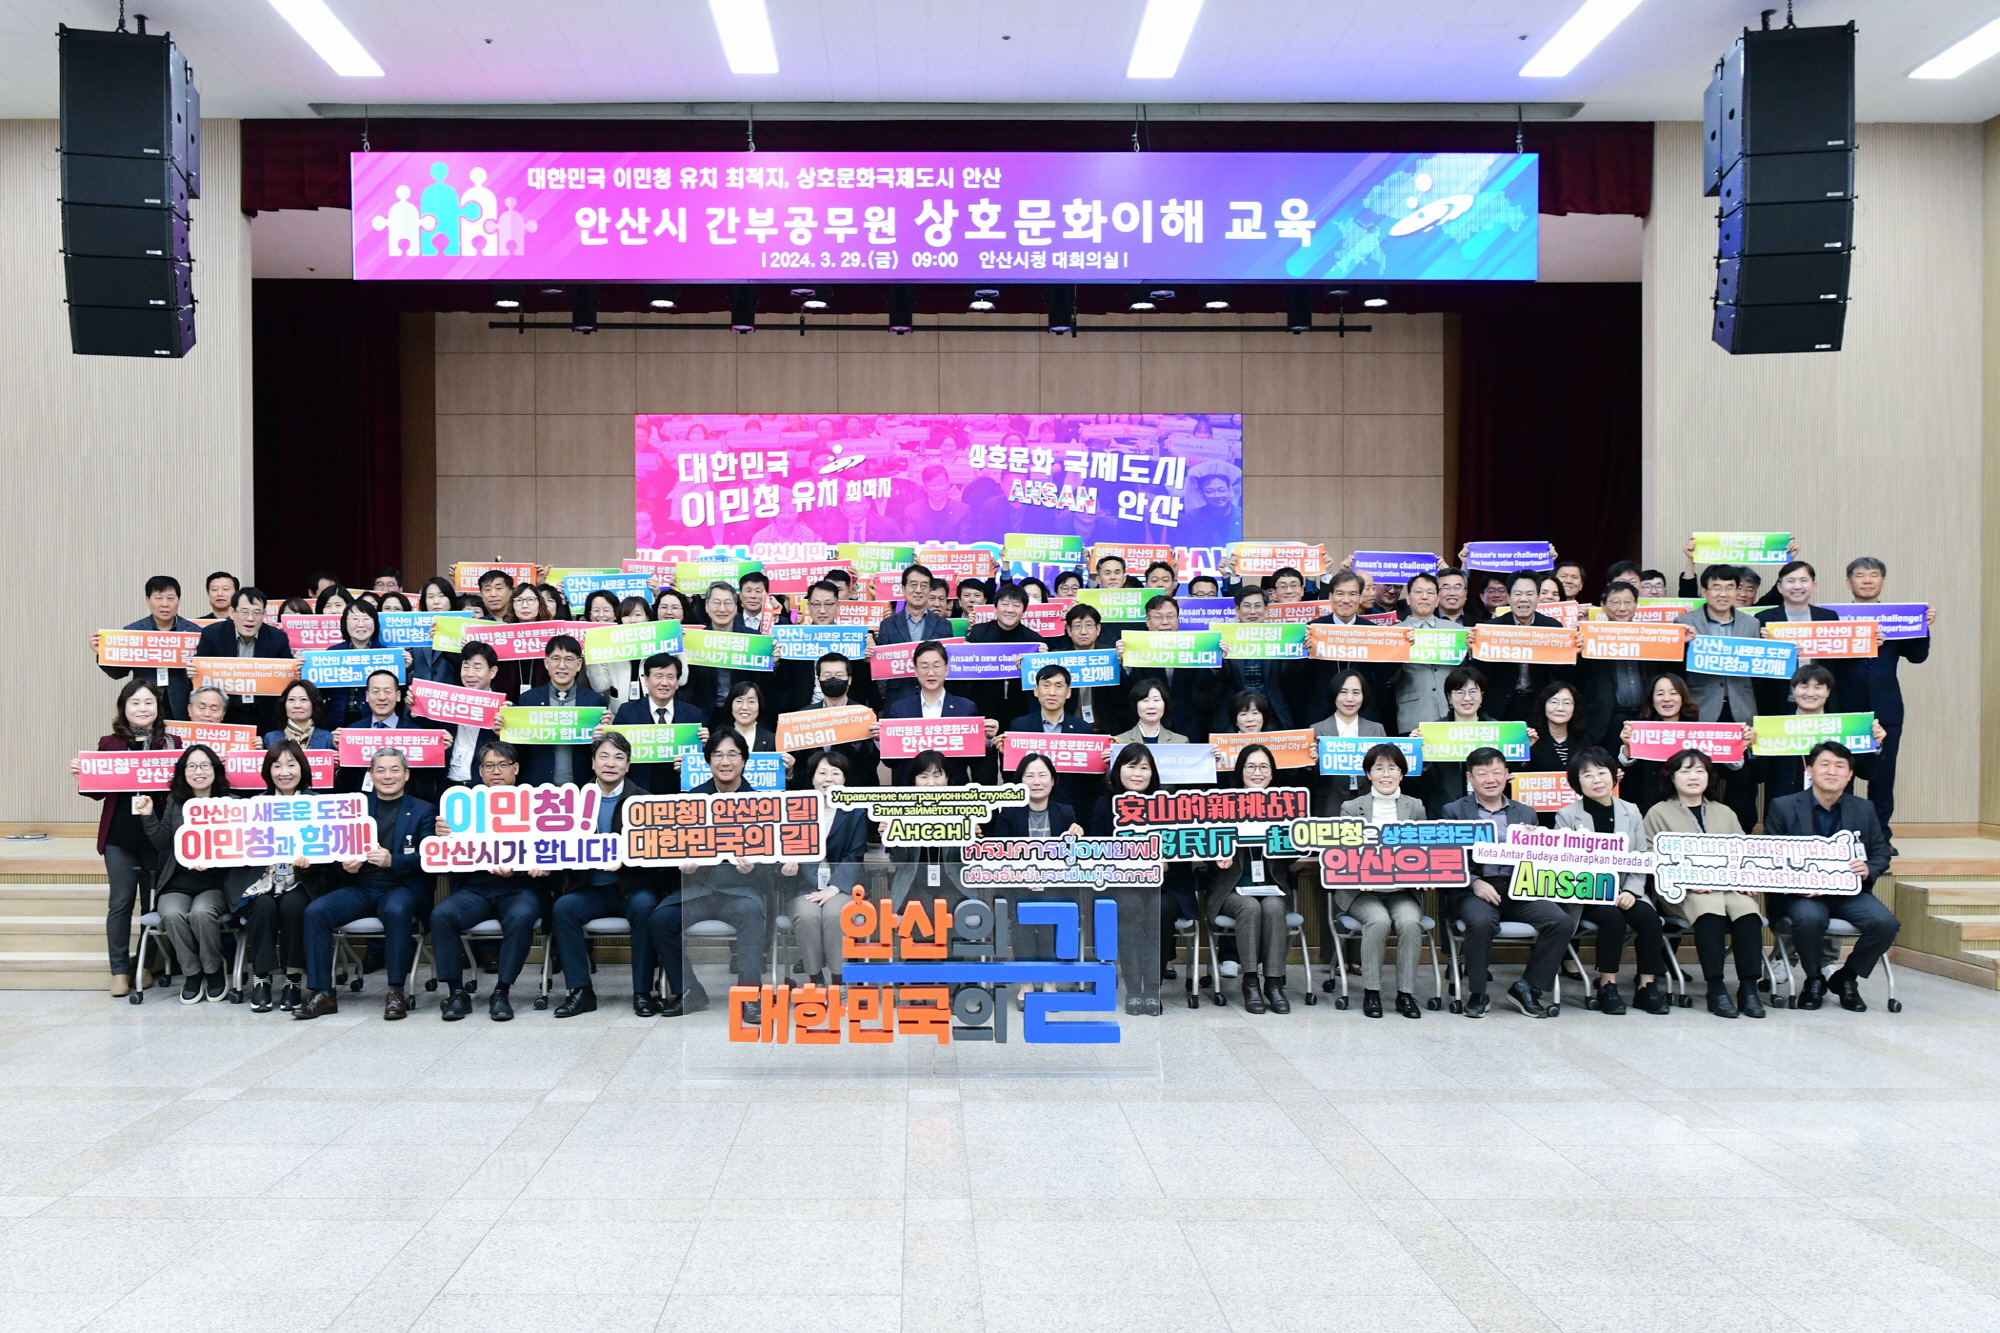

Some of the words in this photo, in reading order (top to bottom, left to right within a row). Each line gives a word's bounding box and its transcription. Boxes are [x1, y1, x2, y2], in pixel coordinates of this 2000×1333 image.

[527, 167, 606, 189] 대한민국
[613, 167, 672, 189] 이민청
[679, 167, 718, 189] 유치
[725, 167, 789, 190] 최적지,
[796, 167, 954, 189] 상호문화국제도시
[962, 167, 1002, 189] 안산
[575, 206, 686, 246] 안산시
[705, 206, 897, 246] 간부공무원
[914, 198, 1204, 247] 상호문화이해
[1225, 198, 1316, 247] 교육
[820, 251, 836, 268] 3.
[840, 250, 899, 270] 29.(금)
[912, 251, 959, 268] 09:00
[979, 251, 1047, 269] 안산시청
[1052, 251, 1119, 269] 대회의실
[678, 450, 789, 484] 대한민국
[968, 443, 1054, 477] 상호문화
[1063, 450, 1186, 490] 국제도시
[680, 483, 781, 528] 이민청
[791, 478, 838, 513] 유치
[845, 477, 892, 503] 최적지
[1008, 479, 1098, 515] ANSAN
[1117, 491, 1185, 528] 안산
[1025, 537, 1063, 549] 이민청!
[1719, 534, 1766, 548] 이민청!
[857, 547, 894, 560] 이민청!
[1470, 551, 1496, 559] Ansan's
[1513, 551, 1550, 560] challenge!
[1697, 548, 1745, 561] 안산시가
[1747, 549, 1787, 562] 합니다!
[698, 565, 739, 577] 이민청!
[1355, 560, 1382, 569] Ansan's
[1399, 561, 1436, 571] challenge!
[767, 567, 808, 581] 이민청은
[1099, 592, 1142, 605] 이민청!
[1179, 608, 1205, 616] Ansan's
[286, 620, 319, 629] 이민청은
[1587, 625, 1599, 633] The
[1600, 626, 1639, 636] Immigration
[1640, 626, 1679, 636] Department
[1773, 626, 1812, 638] 이민청!
[1816, 626, 1852, 638] 안산의
[1855, 626, 1871, 637] 길!
[610, 626, 656, 644] 이민청!
[777, 629, 812, 642] 안산의
[813, 632, 841, 642] 새로운
[842, 632, 863, 642] 도전!
[1235, 627, 1282, 641] 이민청!
[1315, 628, 1327, 636] The
[1327, 628, 1366, 638] Immigration
[1366, 630, 1403, 639] Department
[1492, 630, 1531, 639] Immigration
[1532, 631, 1570, 640] Department
[589, 643, 639, 660] 안산시가
[640, 638, 678, 656] 합니다!
[704, 635, 749, 652] 이민청!
[1148, 635, 1195, 649] 이민청!
[1315, 641, 1368, 659] Ansan
[1586, 638, 1641, 657] Ansan
[1693, 638, 1733, 656] 안산의
[1733, 645, 1766, 658] 새로운
[1767, 647, 1791, 659] 도전!
[950, 654, 980, 663] Ansan's
[981, 655, 997, 663] new
[1127, 650, 1175, 664] 안산시가
[1178, 651, 1217, 664] 합니다!
[1478, 641, 1533, 660] Ansan
[199, 661, 211, 669] The
[212, 661, 253, 671] Immigration
[254, 662, 293, 672] Department
[311, 655, 340, 666] 안산의
[341, 654, 371, 665] 새로운
[372, 654, 394, 664] 도전!
[1694, 655, 1749, 673] 이민청과
[1751, 658, 1786, 675] 함께!
[308, 666, 363, 683] 이민청과
[950, 664, 962, 672] The
[962, 664, 999, 674] Immigration
[1081, 667, 1114, 683] 함께!
[416, 686, 448, 700] 이민청은
[450, 691, 499, 708] 상호문화도시
[427, 699, 484, 722] 안산으로
[528, 711, 578, 726] 이민청!
[505, 727, 557, 741] 안산시가
[886, 725, 923, 737] 이민청은
[925, 724, 979, 737] 상호문화도시
[1448, 726, 1500, 741] 이민청!
[1784, 717, 1842, 735] 이민청!
[346, 735, 383, 745] 이민청은
[385, 736, 438, 746] 상호문화도시
[626, 728, 675, 744] 이민청!
[783, 726, 836, 749] Ansan
[901, 735, 965, 752] 안산으로
[1216, 737, 1229, 745] The
[1229, 736, 1269, 746] Immigration
[1269, 734, 1307, 745] Department
[1631, 729, 1685, 745] 이민청은
[1687, 730, 1743, 741] 상호문화도시
[1010, 738, 1047, 750] 이민청은
[1049, 739, 1104, 752] 상호문화도시
[1326, 741, 1356, 752] 안산의
[1518, 777, 1556, 790] 이민청!
[832, 790, 897, 803] Управление
[898, 790, 978, 803] миграционной
[978, 788, 1025, 803] службы!
[189, 803, 248, 826] 안산의
[252, 800, 311, 823] 새로운
[317, 799, 362, 821] 도전!
[445, 788, 597, 834] 이민청!
[629, 800, 705, 828] 이민청!
[712, 797, 780, 824] 안산의
[786, 796, 817, 822] 길!
[873, 804, 903, 816] Этим
[903, 803, 953, 817] займётся
[954, 804, 986, 818] город
[1117, 792, 1308, 824] 安山的新挑战!
[887, 819, 973, 841] Ансан!
[1294, 820, 1378, 847] 이민청은
[1382, 823, 1493, 845] 상호문화도시
[181, 826, 296, 860] 이민청과
[300, 823, 372, 857] 함께!
[628, 824, 775, 860] 대한민국의
[780, 823, 820, 856] 길!
[1511, 830, 1560, 848] Kantor
[1563, 833, 1624, 853] Imigrant
[424, 840, 528, 867] 안산시가
[534, 837, 618, 864] 합니다!
[1477, 847, 1498, 859] Kota
[1500, 848, 1524, 860] Antar
[1526, 850, 1559, 863] Budaya
[1560, 851, 1610, 866] diharapkan
[1611, 854, 1643, 868] berada
[1644, 856, 1653, 868] di
[1324, 847, 1465, 884] 안산으로
[1513, 860, 1615, 901] Ansan
[840, 885, 1008, 959] 안산의
[729, 983, 1008, 1045] 대한민국의
